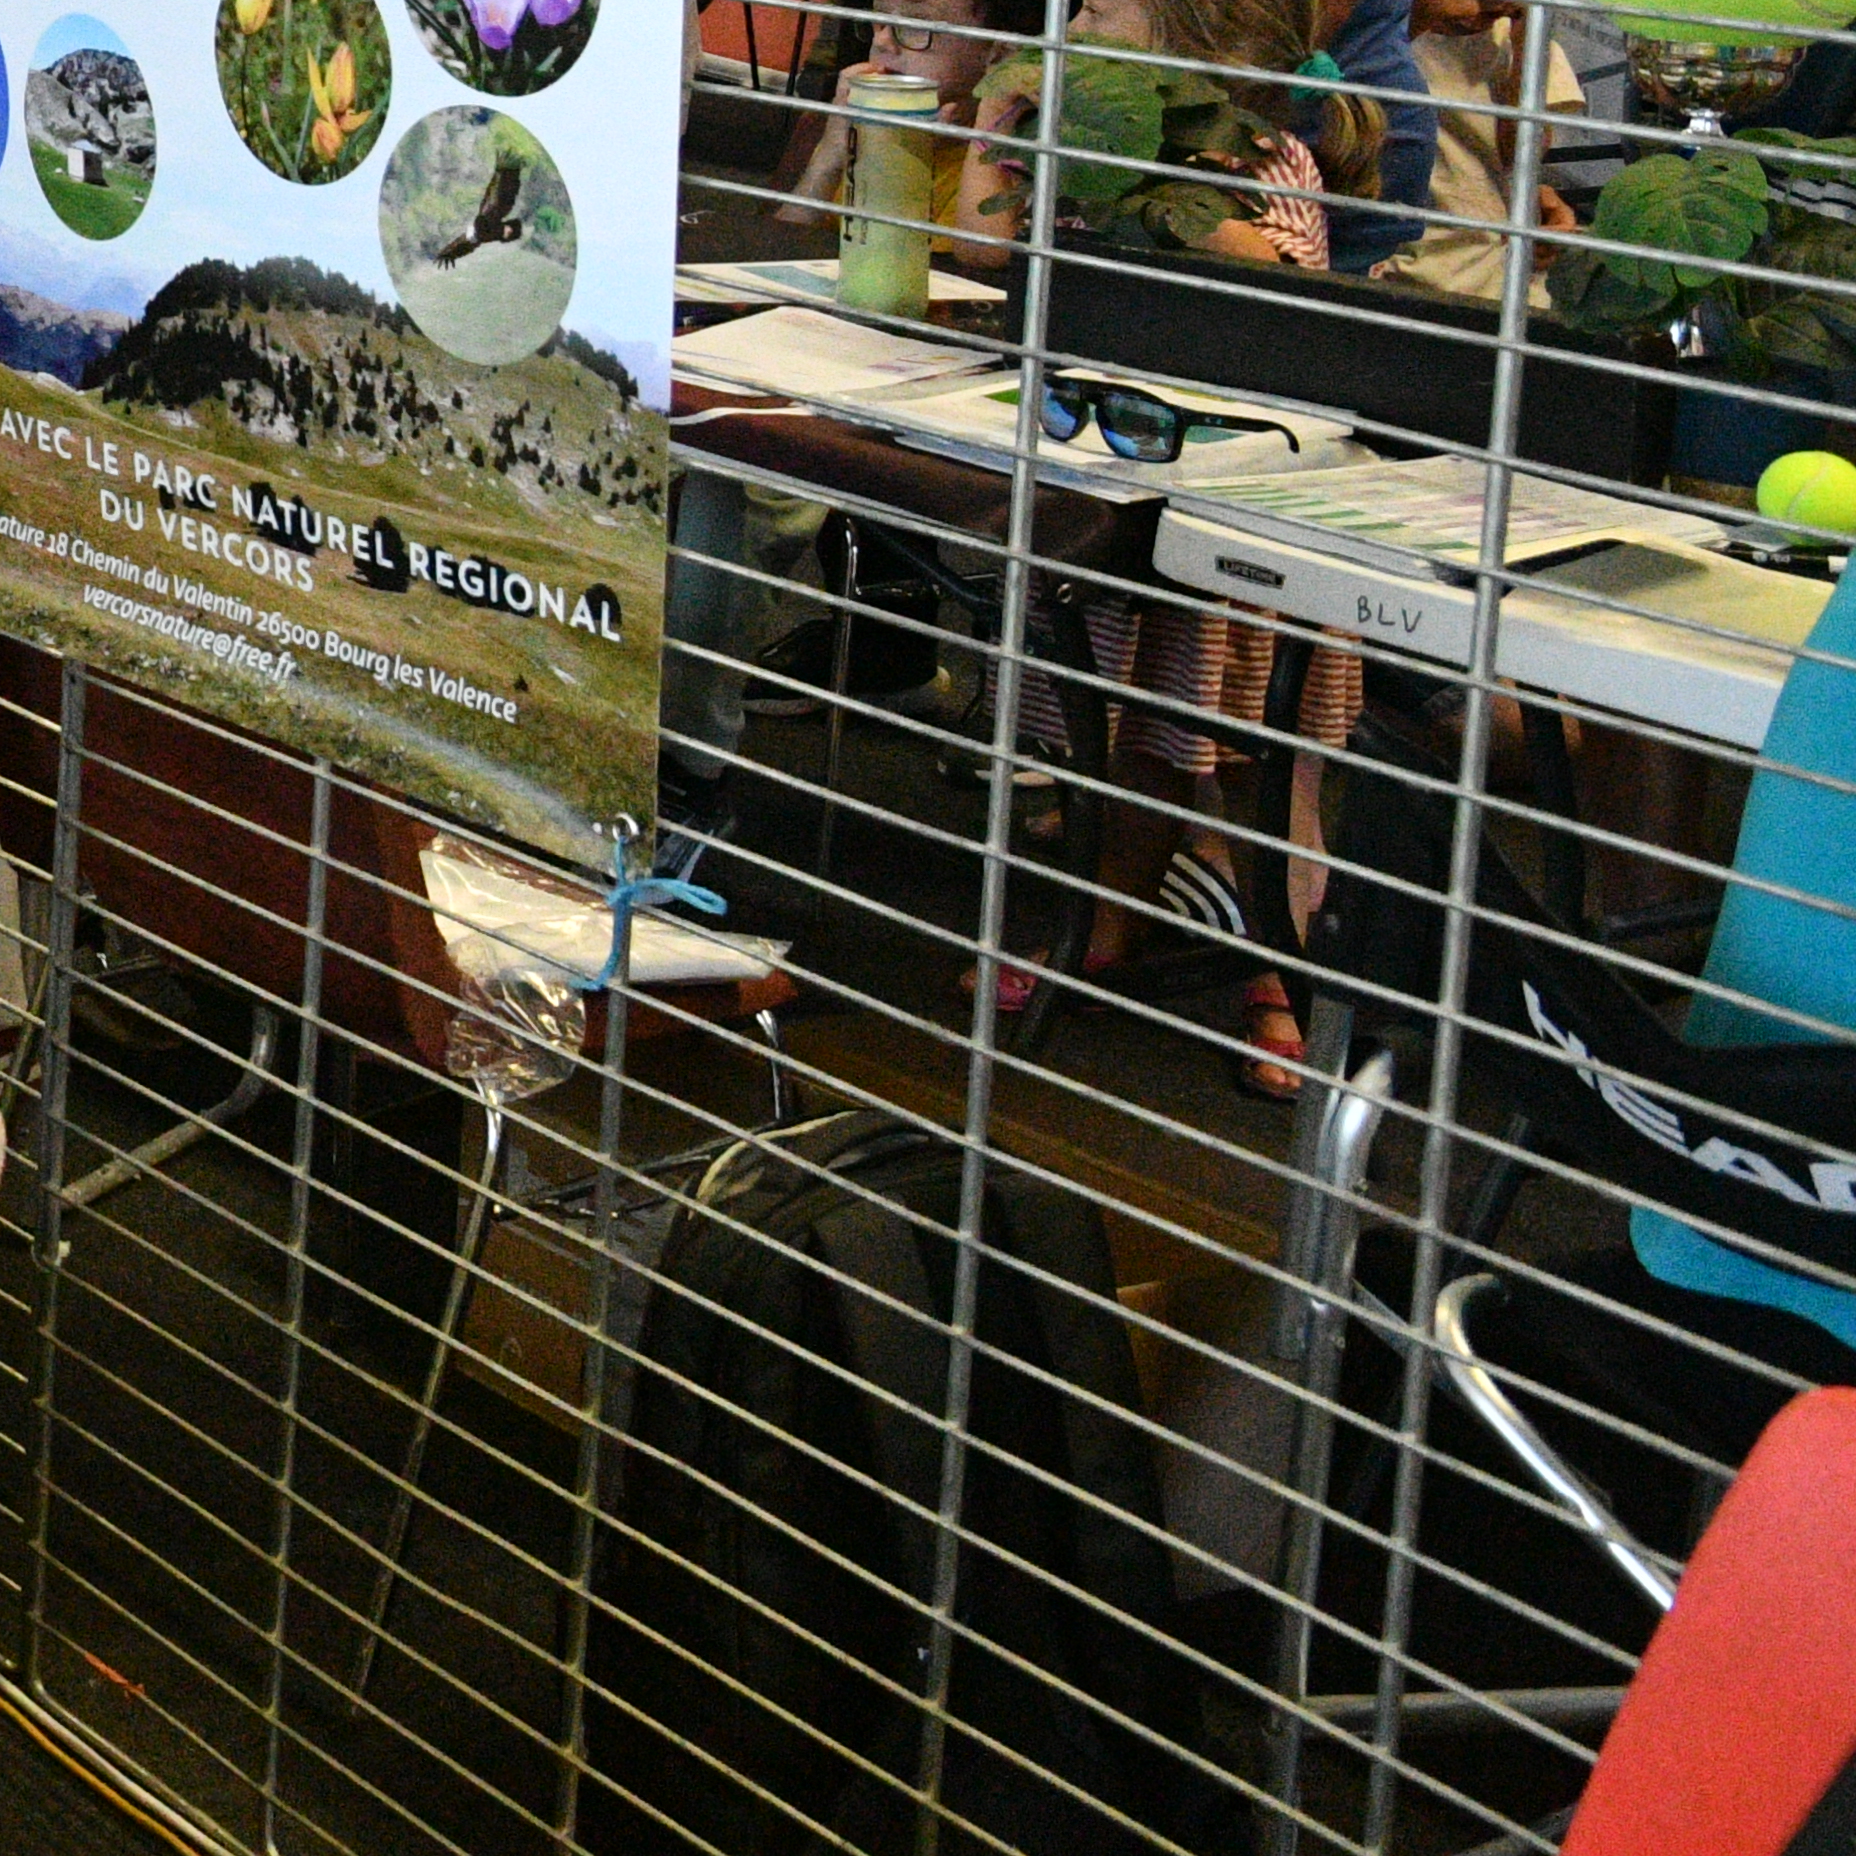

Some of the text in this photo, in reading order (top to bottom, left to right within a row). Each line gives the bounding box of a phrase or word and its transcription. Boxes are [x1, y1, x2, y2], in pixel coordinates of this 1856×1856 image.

[0, 406, 74, 463] AVEC
[85, 435, 120, 477] LE
[133, 450, 218, 510] PARC
[231, 484, 397, 568] NATUREL
[408, 544, 622, 643] REGIONAL
[98, 487, 316, 593] DU VERCORS
[46, 530, 69, 558] 18
[71, 538, 140, 583] Chemin
[142, 561, 167, 592] du
[171, 570, 254, 621] Valentin
[255, 607, 321, 651] 26500
[323, 628, 391, 682] Bourg
[392, 651, 425, 690] les
[428, 666, 520, 724] Valence
[83, 583, 299, 682] vercorsnature@free.fr
[1357, 595, 1422, 633] BLV
